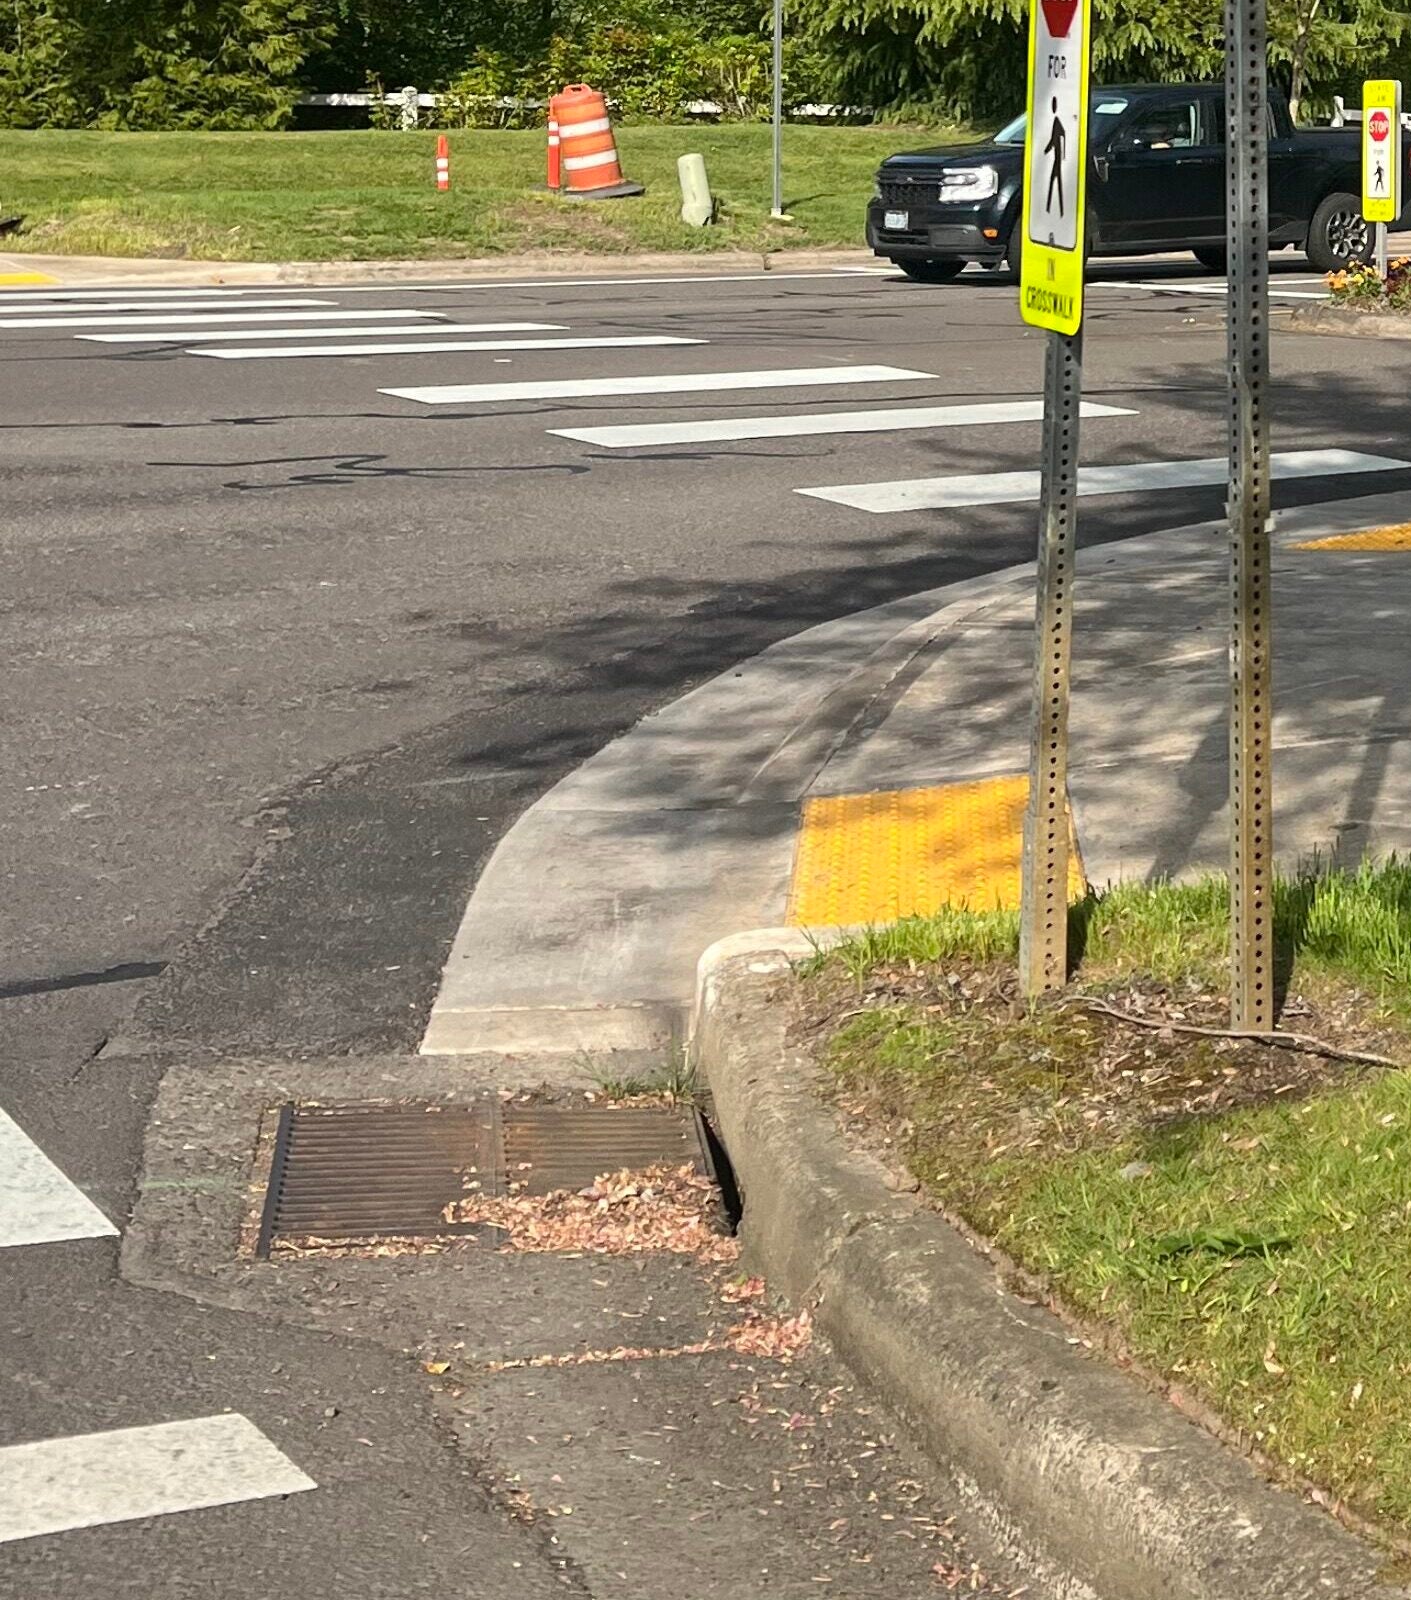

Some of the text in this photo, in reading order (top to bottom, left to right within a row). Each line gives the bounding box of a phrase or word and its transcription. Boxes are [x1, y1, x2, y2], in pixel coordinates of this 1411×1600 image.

[1048, 54, 1067, 80] FOR
[1369, 119, 1389, 134] STOP
[1026, 285, 1074, 320] CROSSWALK
